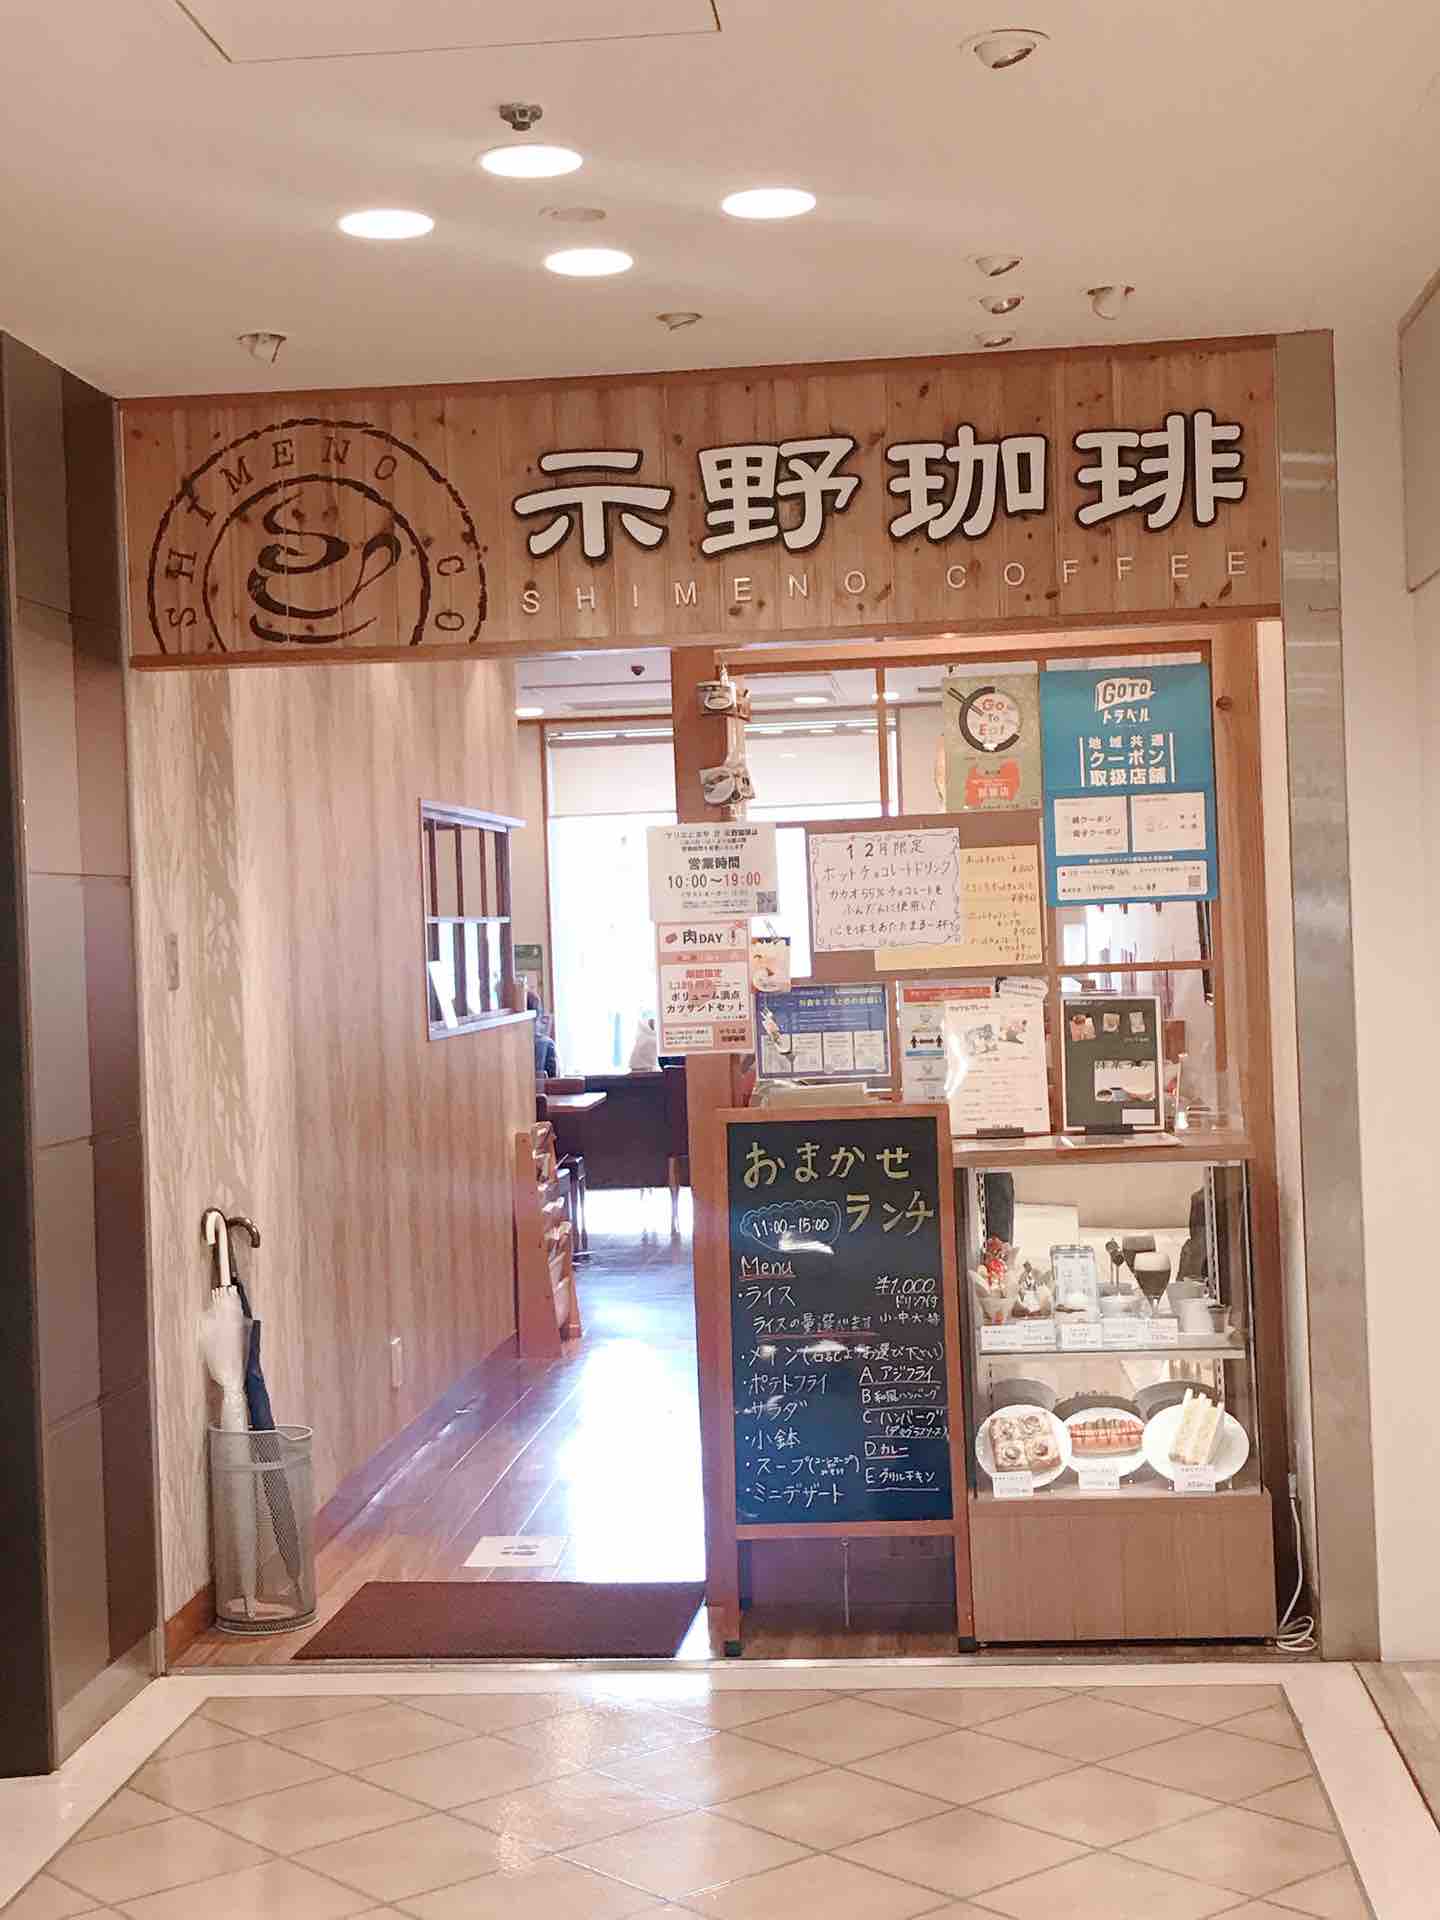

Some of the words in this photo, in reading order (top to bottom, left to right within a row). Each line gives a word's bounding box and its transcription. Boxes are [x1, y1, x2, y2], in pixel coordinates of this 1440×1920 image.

[512, 409, 1248, 560] 示野珈琲
[520, 568, 868, 616] SHIMENO
[944, 551, 1249, 591] COFFEE
[1103, 707, 1151, 725] トラベル
[1088, 733, 1165, 750] 地域共通
[1090, 750, 1165, 768] クーポン
[1090, 766, 1167, 787] 取扱店舗
[688, 855, 740, 870] 営業時間
[743, 1142, 912, 1188] おまかせ
[847, 1190, 934, 1237] ランチ
[740, 1255, 793, 1278] Menu
[745, 1285, 796, 1309] ライス
[749, 1373, 829, 1395] ポテトフライ
[859, 1367, 875, 1383] A
[880, 1365, 934, 1383] アジフライ
[861, 1388, 872, 1404] B
[749, 1399, 809, 1421] サラダ
[862, 1409, 872, 1425] C
[879, 1409, 944, 1426] ハンバーグ
[751, 1428, 800, 1450] 小鉢
[864, 1441, 877, 1456] D
[880, 1442, 909, 1456] カレー
[865, 1467, 876, 1484] E
[879, 1467, 935, 1483] グリルチキン
[752, 1482, 844, 1508] ミニデザート
